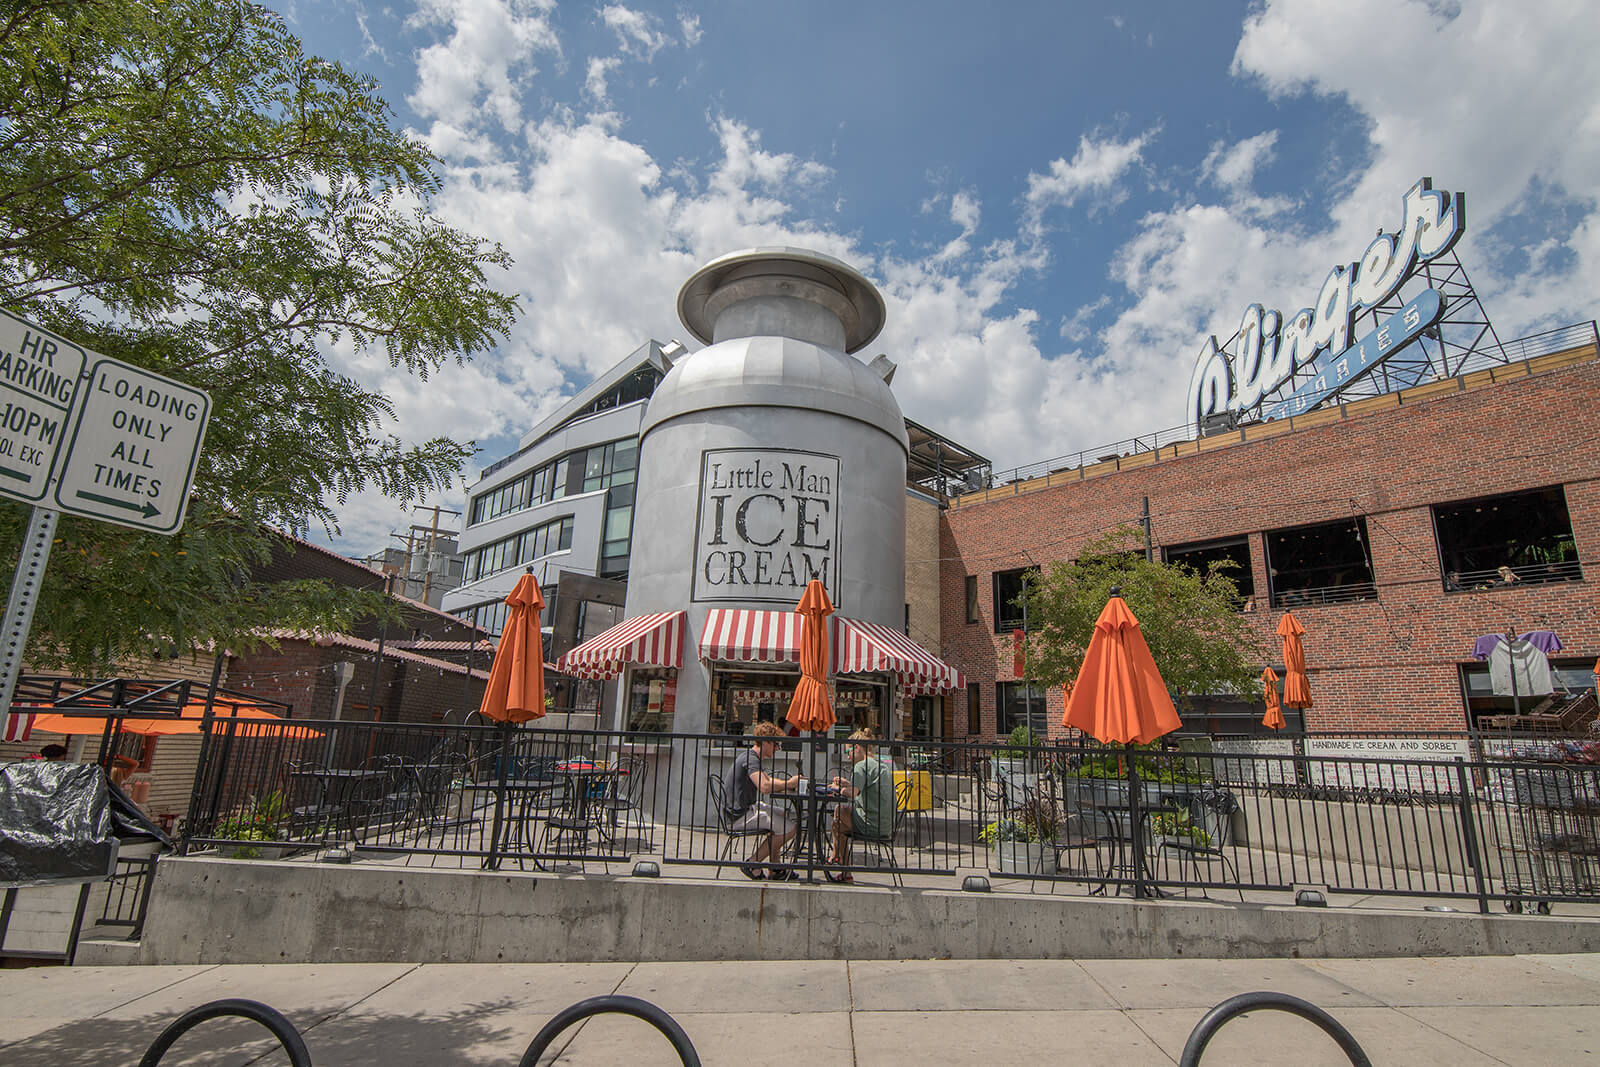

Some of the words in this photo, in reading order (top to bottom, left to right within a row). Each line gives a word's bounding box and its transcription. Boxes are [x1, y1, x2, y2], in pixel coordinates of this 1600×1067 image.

[19, 330, 59, 367] HR
[0, 350, 73, 403] ARKING
[99, 373, 199, 421] LOADING
[112, 410, 173, 442] ONLY
[0, 436, 14, 457] OL
[20, 444, 44, 467] EXC
[110, 441, 154, 469] ALL
[93, 463, 162, 498] TIMES
[711, 459, 773, 490] Little
[780, 462, 832, 495] Man
[707, 493, 831, 551] ICE
[704, 550, 831, 591] CREAM
[1312, 741, 1351, 750] HANDMADE
[1352, 741, 1365, 750] ICE
[1367, 741, 1397, 750] CREAM
[1399, 742, 1419, 750] AND
[1422, 742, 1458, 751] SORBET
